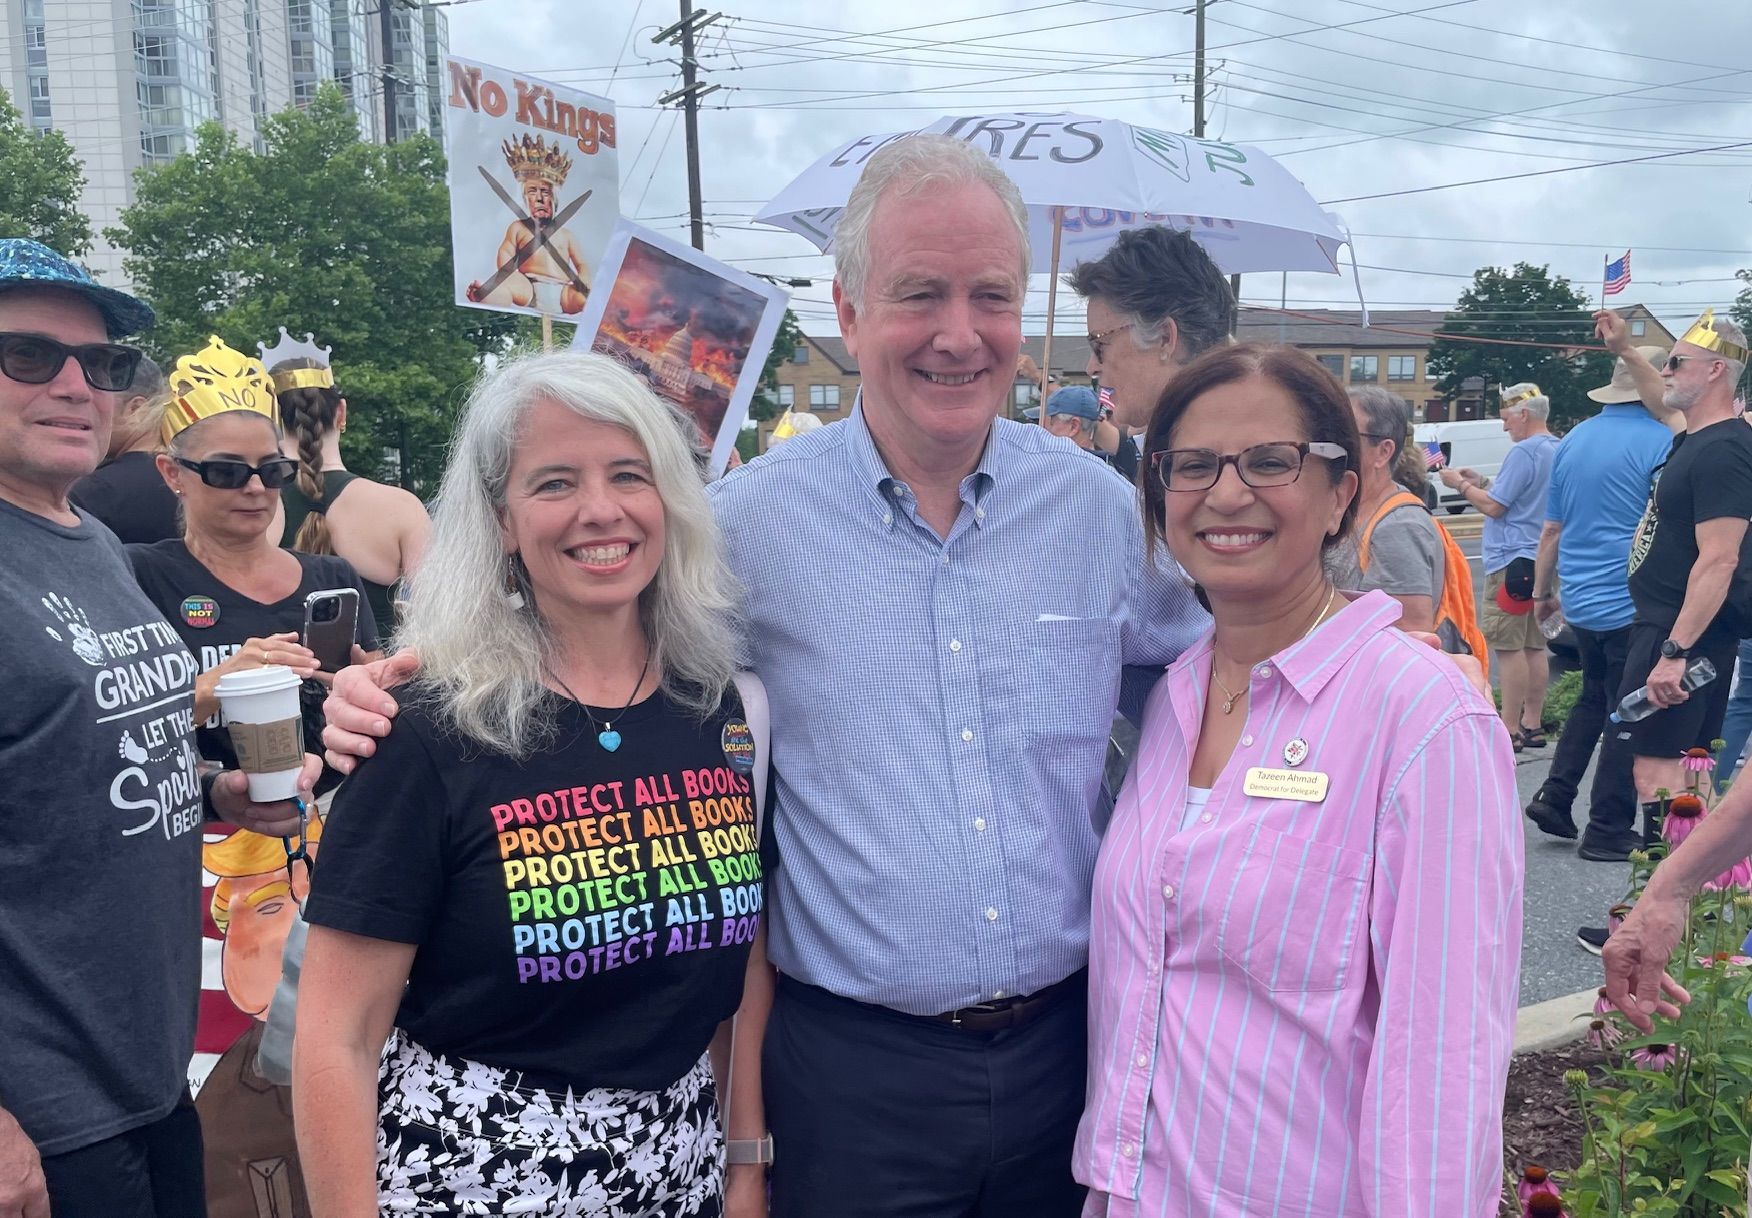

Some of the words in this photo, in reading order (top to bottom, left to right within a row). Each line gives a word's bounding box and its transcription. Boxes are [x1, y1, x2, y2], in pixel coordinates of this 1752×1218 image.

[447, 60, 508, 118] No
[513, 78, 617, 155] Kings
[218, 388, 256, 408] NO
[185, 602, 202, 610] THIS
[203, 602, 214, 610] IS
[100, 625, 149, 658] FIRST
[142, 717, 168, 749] LET
[490, 781, 624, 832] PROTECT
[634, 774, 680, 807] ALL
[682, 767, 750, 799] BOOKS
[1249, 783, 1280, 792] Democrat
[1291, 786, 1319, 796] Delegate
[1258, 771, 1286, 781] Tazeen
[1287, 774, 1318, 784] Ahmad
[497, 811, 633, 860] PROTECT
[643, 804, 688, 838] ALL
[689, 796, 754, 830] BOOKS
[503, 842, 640, 890] PROTECT
[652, 835, 698, 868] ALL
[508, 871, 647, 922] PROTECT
[659, 863, 708, 897] ALL
[513, 902, 654, 954] PROTECT
[665, 893, 714, 927] ALL
[516, 931, 657, 984] PROTECT
[665, 922, 712, 957] ALL
